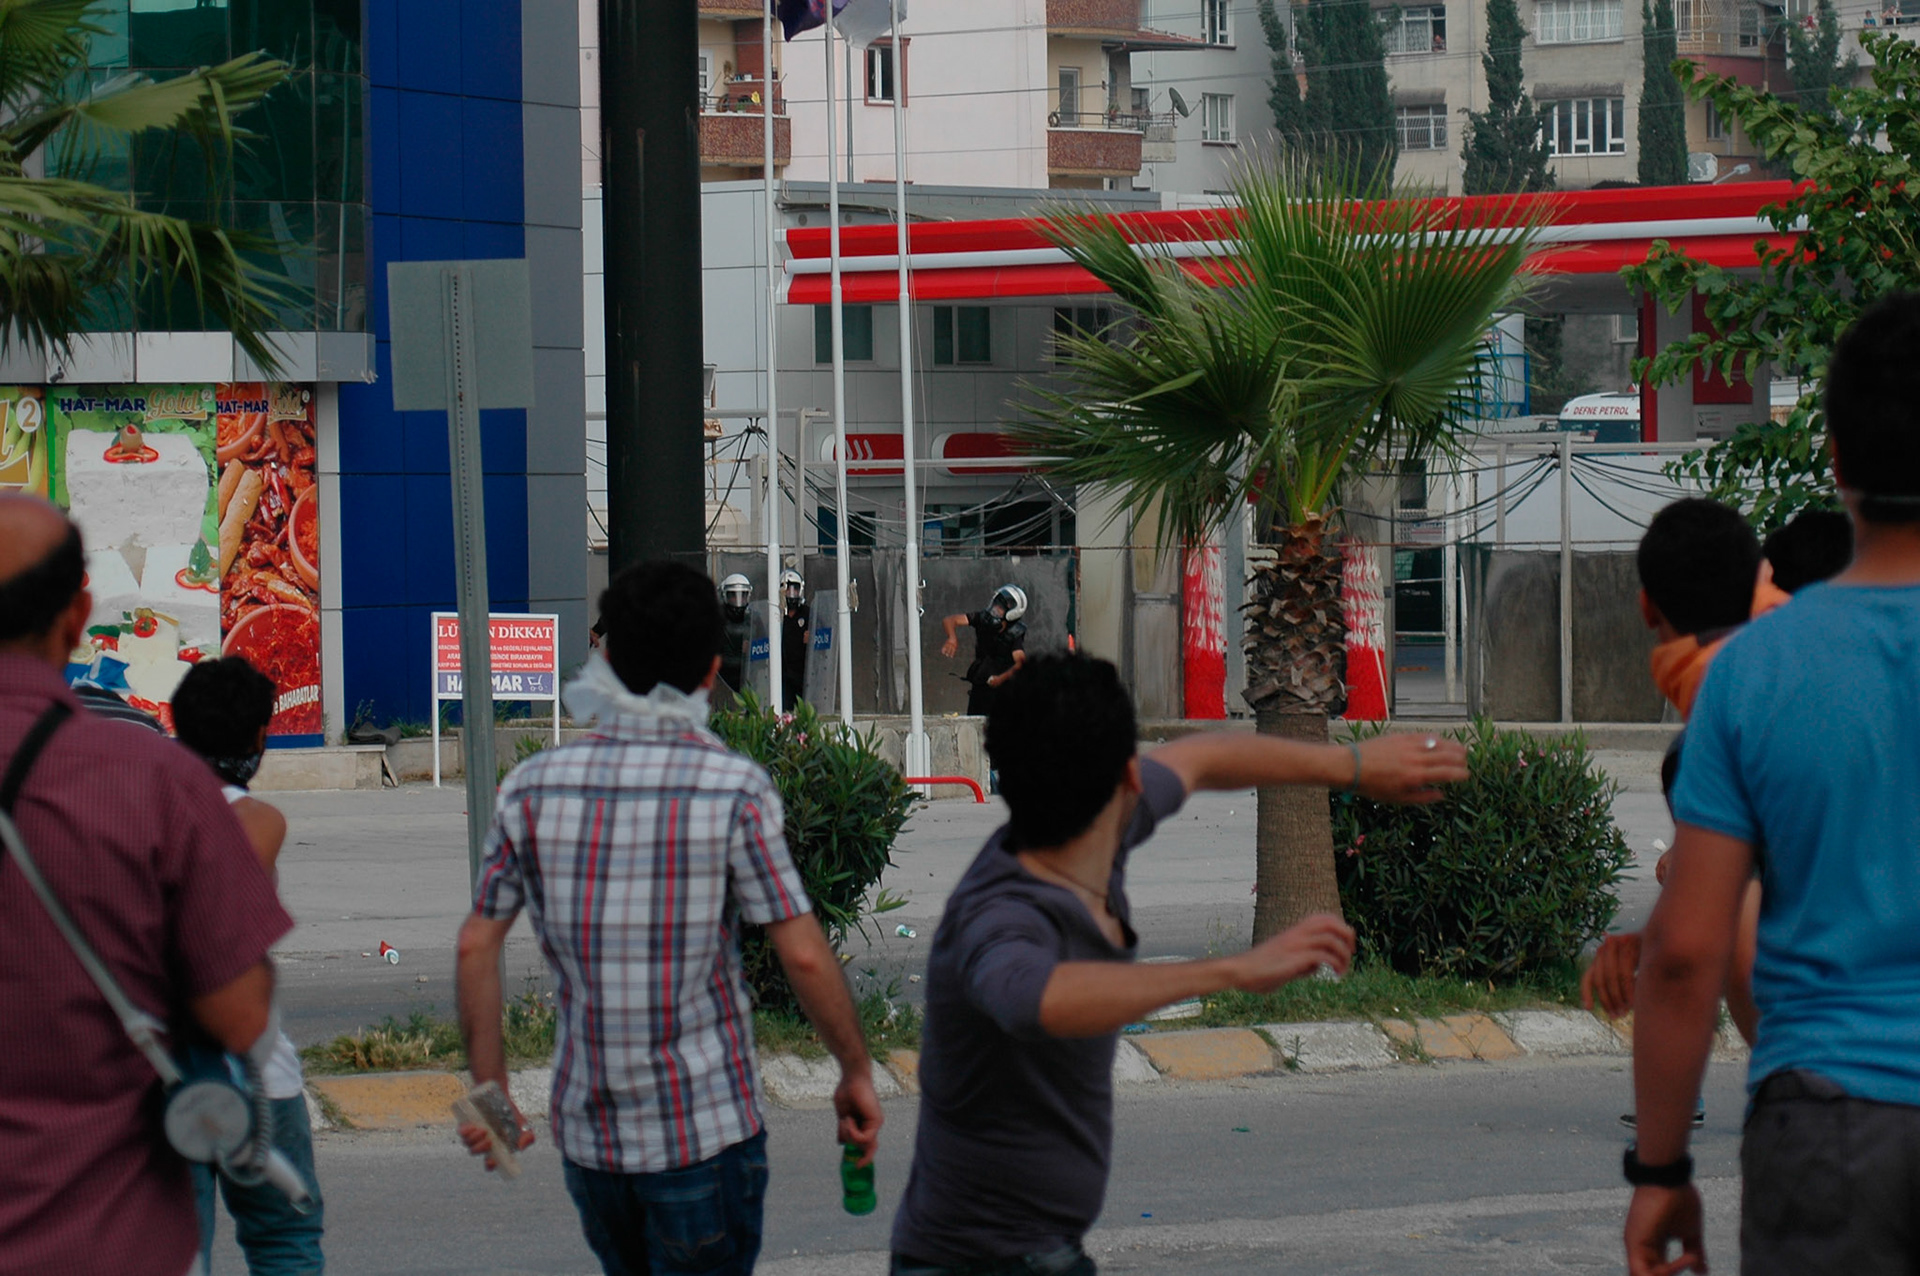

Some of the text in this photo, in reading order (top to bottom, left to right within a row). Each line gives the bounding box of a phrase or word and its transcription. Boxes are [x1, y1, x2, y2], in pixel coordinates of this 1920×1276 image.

[60, 397, 146, 412] HAT-MAR
[150, 389, 202, 418] Gold
[216, 400, 269, 414] HAT-MAR
[1573, 406, 1629, 415] DEFNE PETROL
[22, 400, 36, 427] 2
[438, 623, 552, 638] LÜN DİKKAT
[447, 675, 522, 691] HMAR
[279, 685, 319, 712] BAHARATLAR
